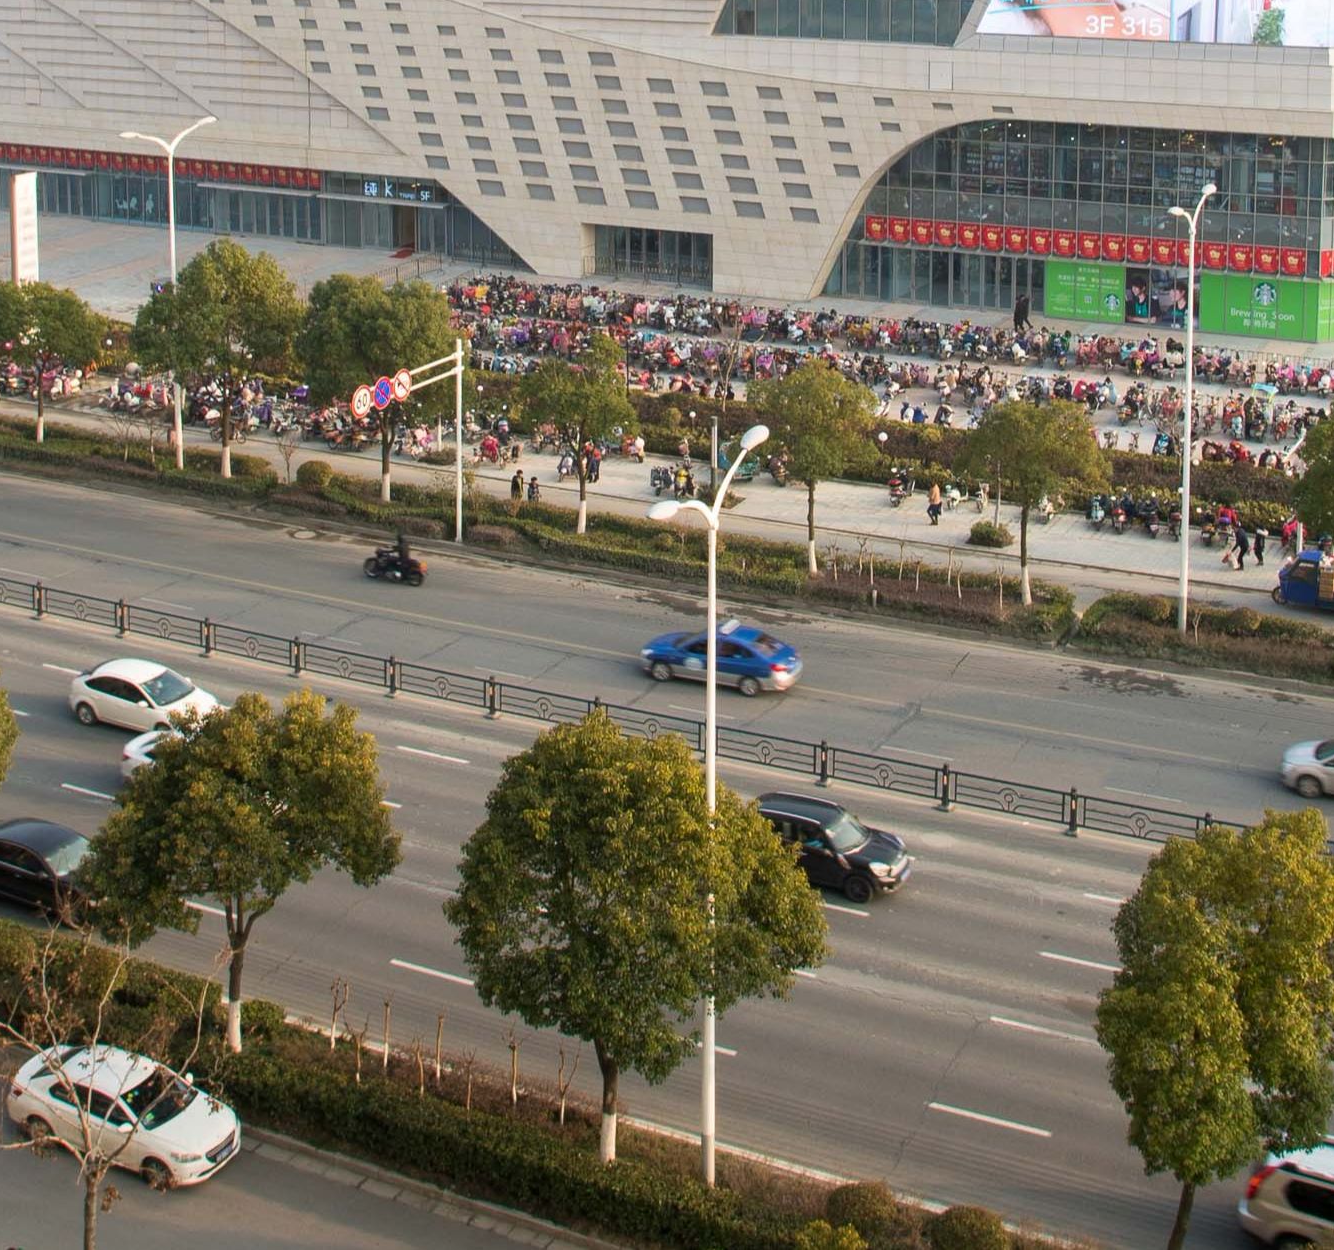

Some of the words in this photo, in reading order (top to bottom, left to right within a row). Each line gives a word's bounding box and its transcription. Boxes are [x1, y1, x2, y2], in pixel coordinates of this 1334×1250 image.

[1086, 16, 1115, 35] 3F
[1121, 17, 1163, 37] 315
[1230, 307, 1267, 321] Brewing
[1272, 308, 1295, 322] Soon
[356, 392, 368, 410] 60
